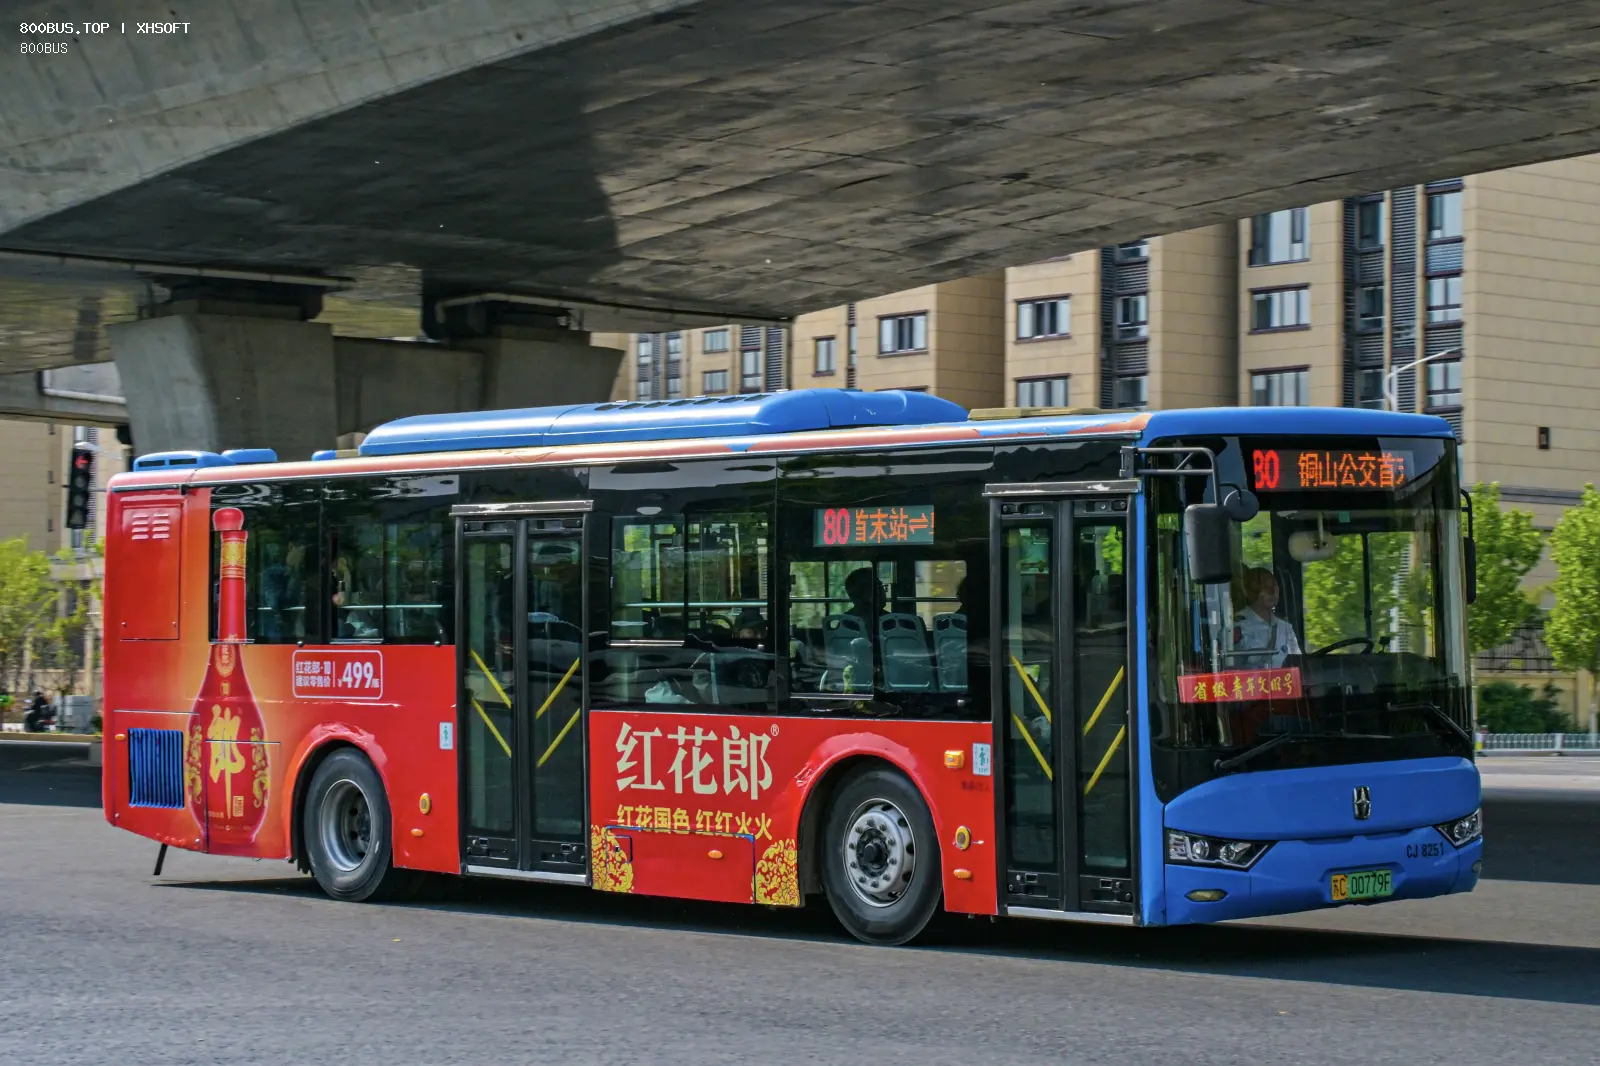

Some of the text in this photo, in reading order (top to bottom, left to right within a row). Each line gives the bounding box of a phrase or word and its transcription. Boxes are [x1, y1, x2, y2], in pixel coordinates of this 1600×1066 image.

[824, 508, 850, 545] 80
[615, 721, 774, 800] 红花郎
[617, 803, 773, 841] 红花国色 红红火火
[1421, 842, 1445, 857] 8251
